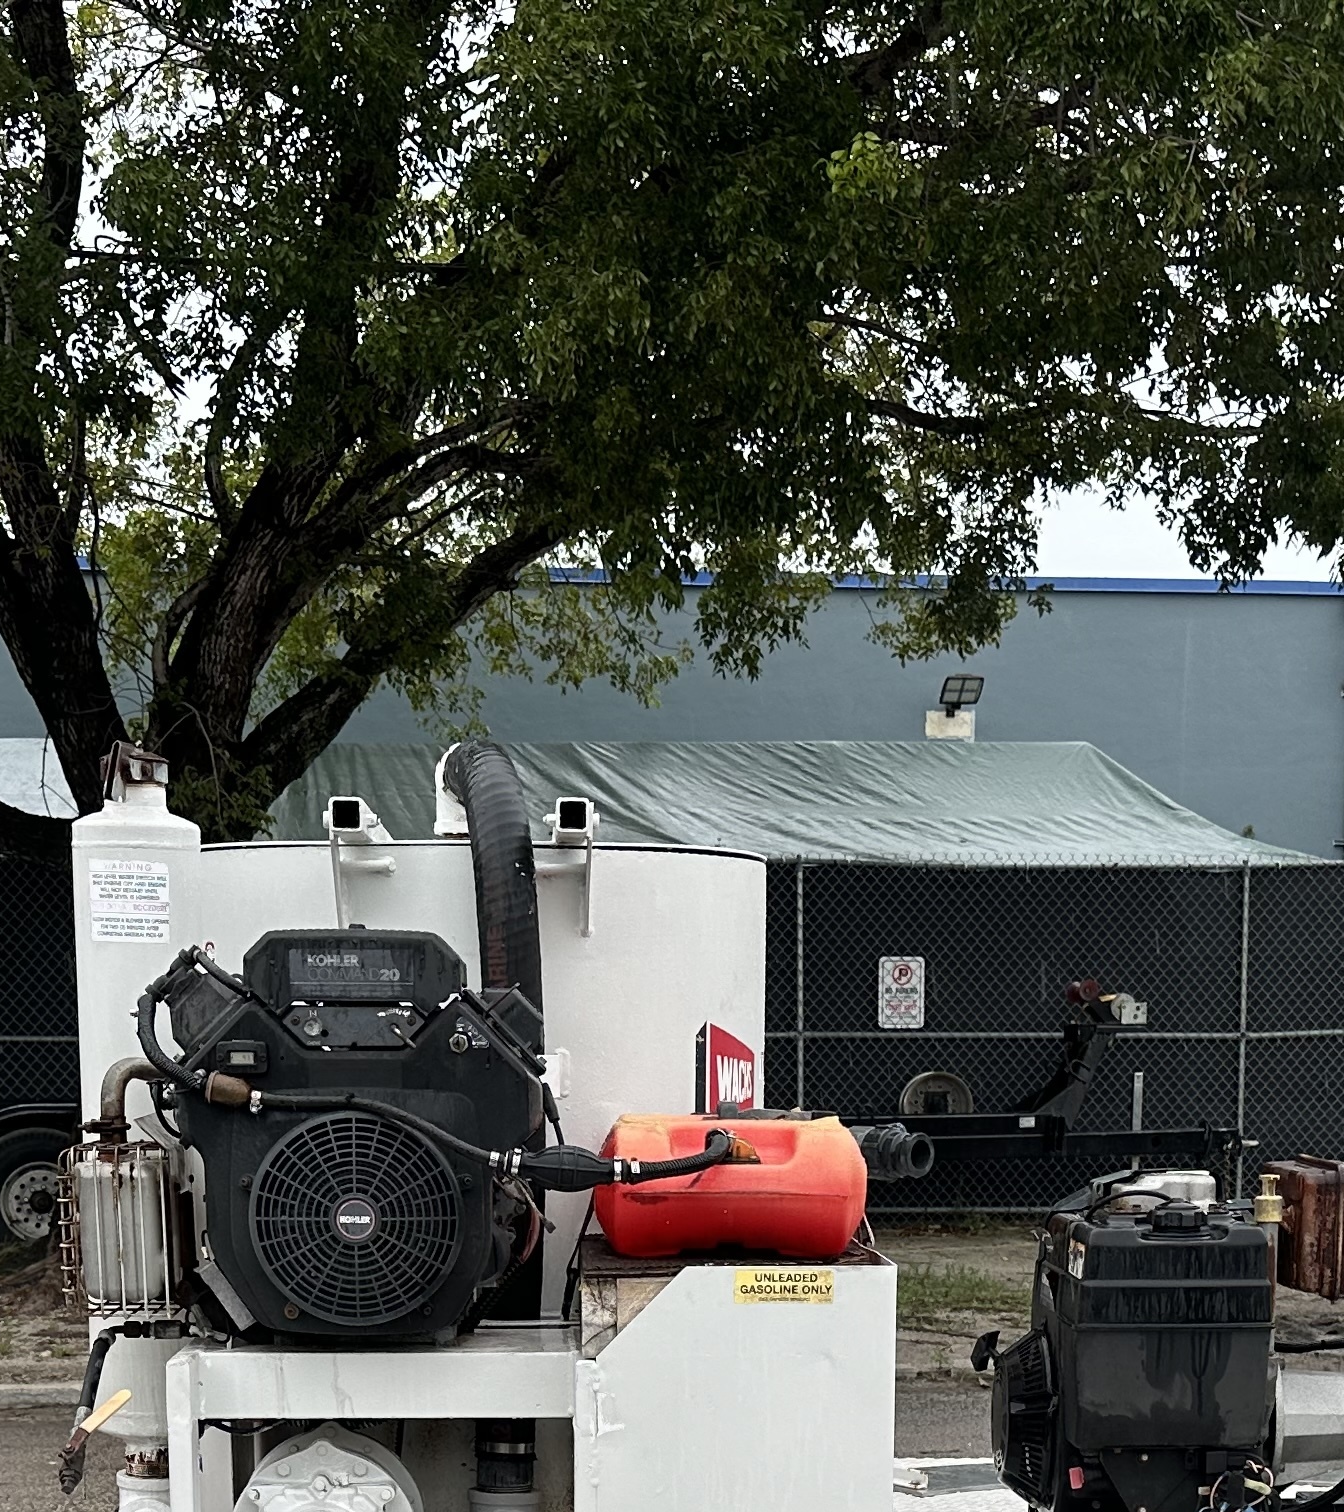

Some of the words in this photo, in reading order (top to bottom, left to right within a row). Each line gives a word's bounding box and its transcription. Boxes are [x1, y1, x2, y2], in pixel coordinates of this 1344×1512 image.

[307, 954, 359, 967] KOHLER
[340, 1215, 371, 1224] KOHLER
[754, 1273, 818, 1283] UNLEADED
[740, 1285, 798, 1294] GASOLINE
[801, 1285, 833, 1295] ONLY
